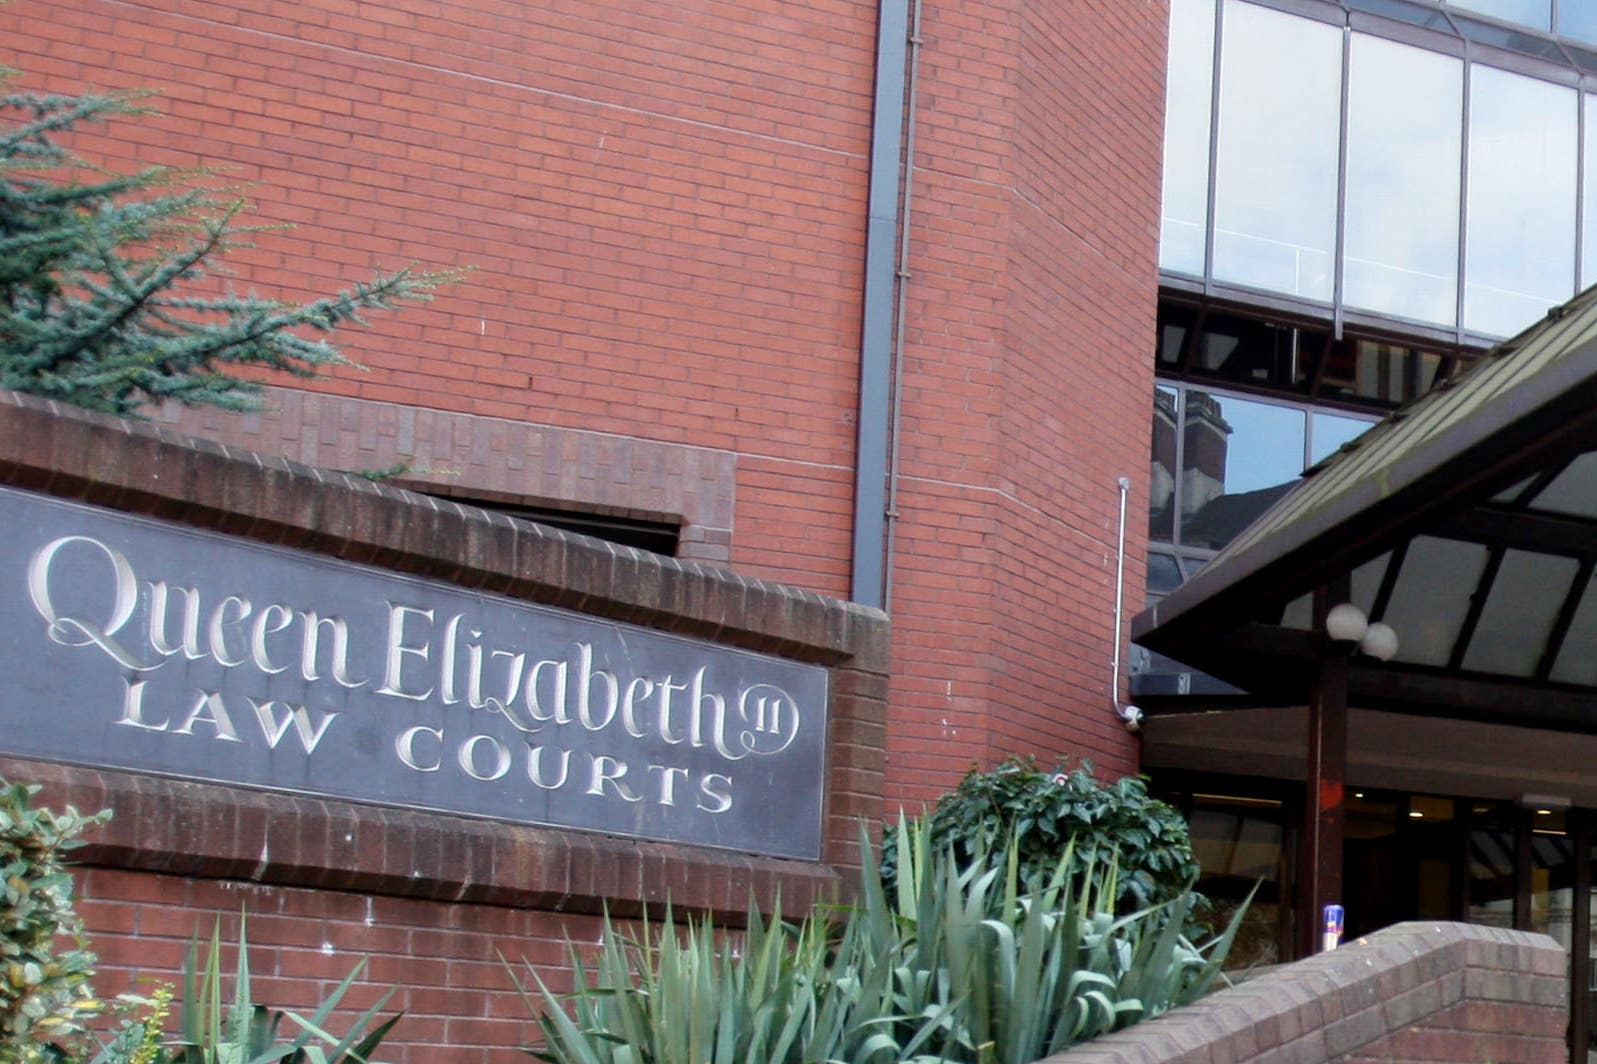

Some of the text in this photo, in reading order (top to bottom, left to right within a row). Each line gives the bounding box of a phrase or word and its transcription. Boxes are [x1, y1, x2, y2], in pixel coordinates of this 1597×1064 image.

[28, 535, 369, 689] Queen
[374, 600, 755, 761] Elizabeth
[112, 675, 735, 814] LAW COURTS
